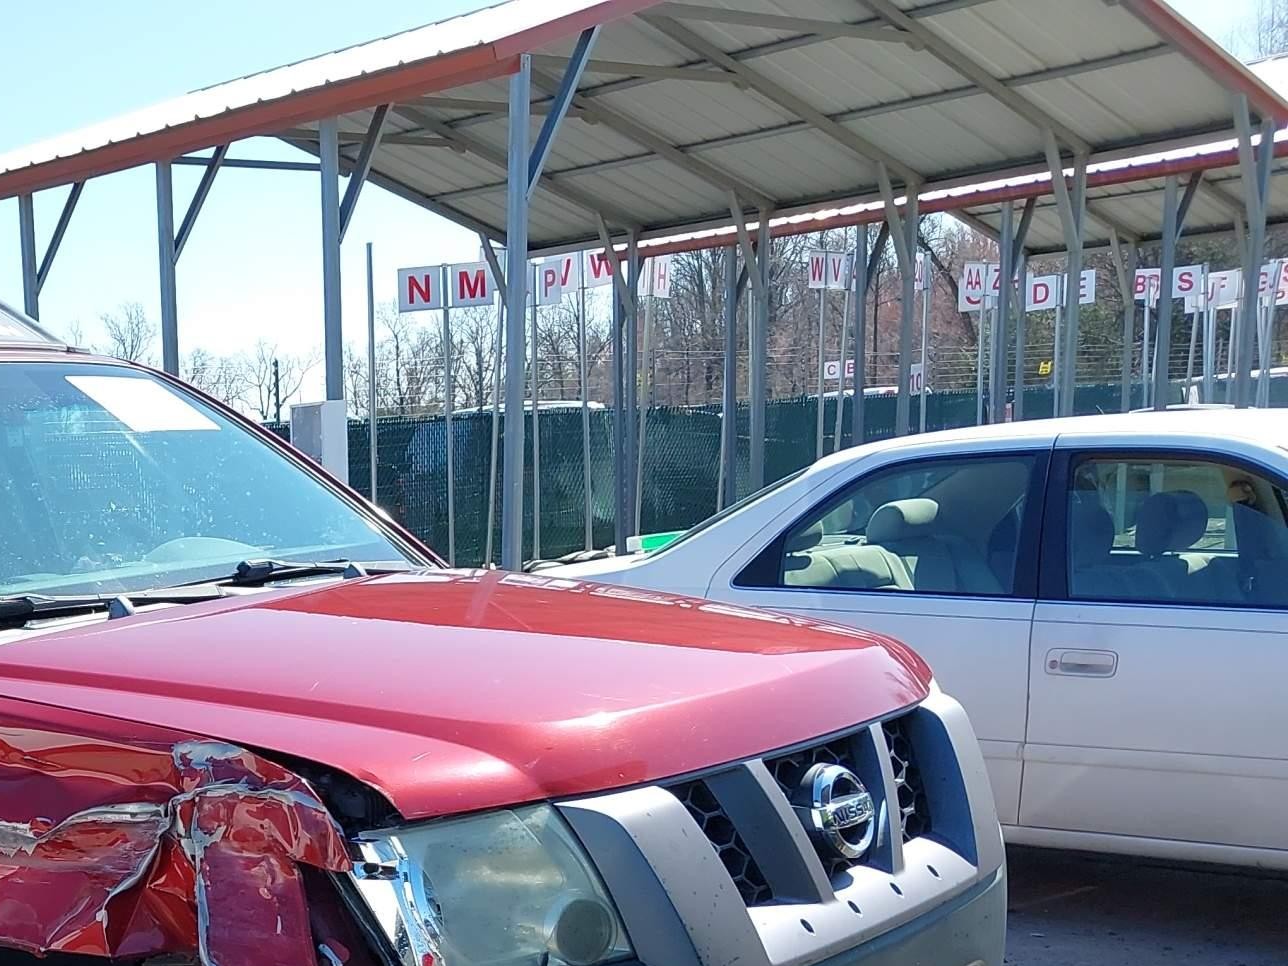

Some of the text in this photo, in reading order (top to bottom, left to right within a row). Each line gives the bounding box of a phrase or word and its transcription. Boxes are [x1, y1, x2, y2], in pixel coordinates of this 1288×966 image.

[657, 262, 667, 289] H
[810, 256, 824, 282] W
[832, 259, 842, 281] V
[966, 268, 982, 290] AA
[408, 274, 431, 304] N
[458, 269, 486, 299] M
[544, 269, 555, 297] P
[1032, 283, 1050, 304] D
[1177, 271, 1194, 292] S
[827, 364, 836, 376] C
